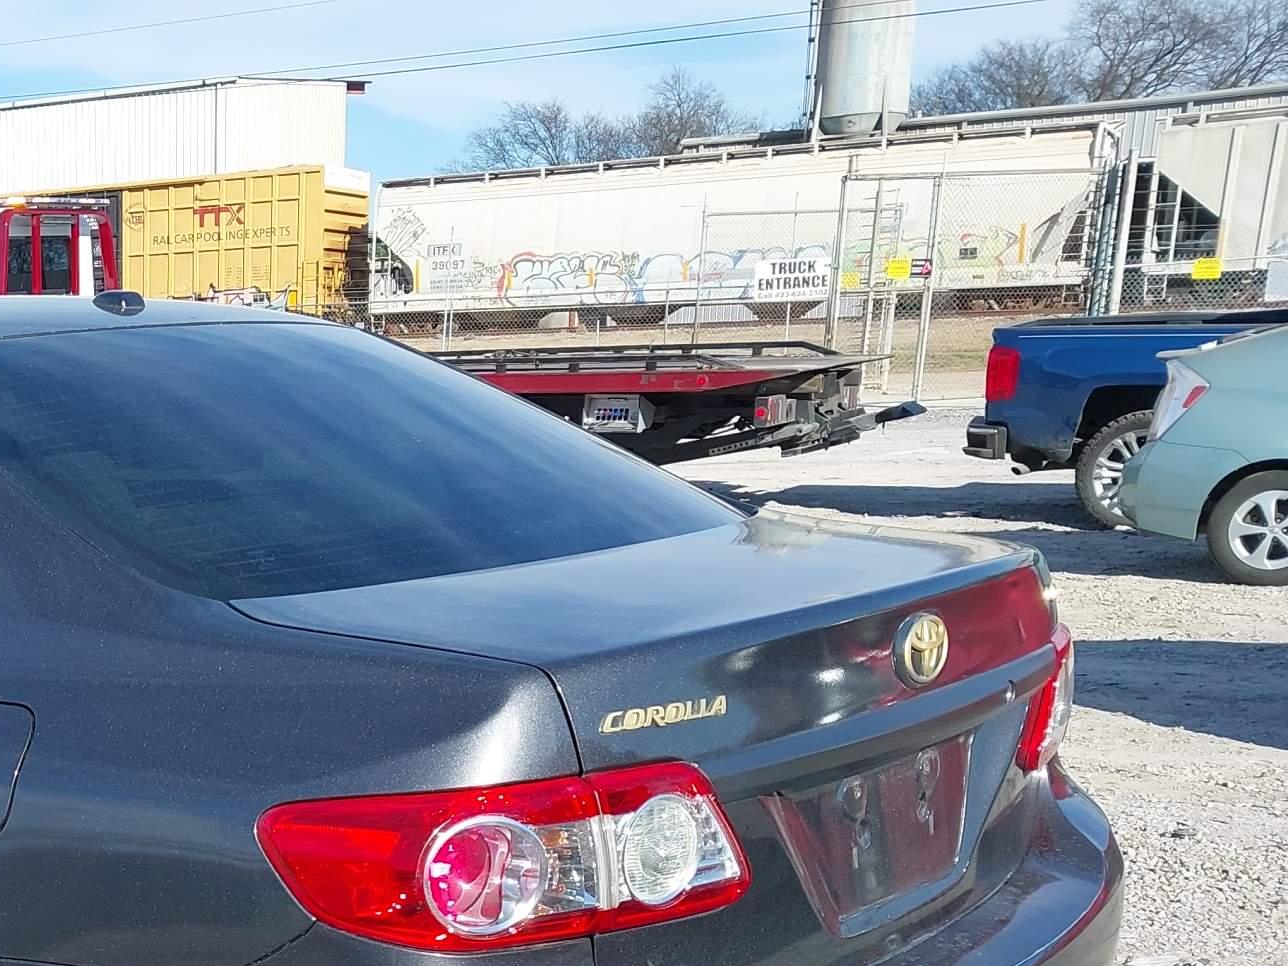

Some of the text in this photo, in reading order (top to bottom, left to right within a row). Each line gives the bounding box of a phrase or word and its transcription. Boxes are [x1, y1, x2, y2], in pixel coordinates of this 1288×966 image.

[194, 204, 245, 228] TTX
[770, 260, 817, 275] TRUCK
[758, 274, 828, 291] ENTRANCE
[599, 695, 728, 734] COROLLA
